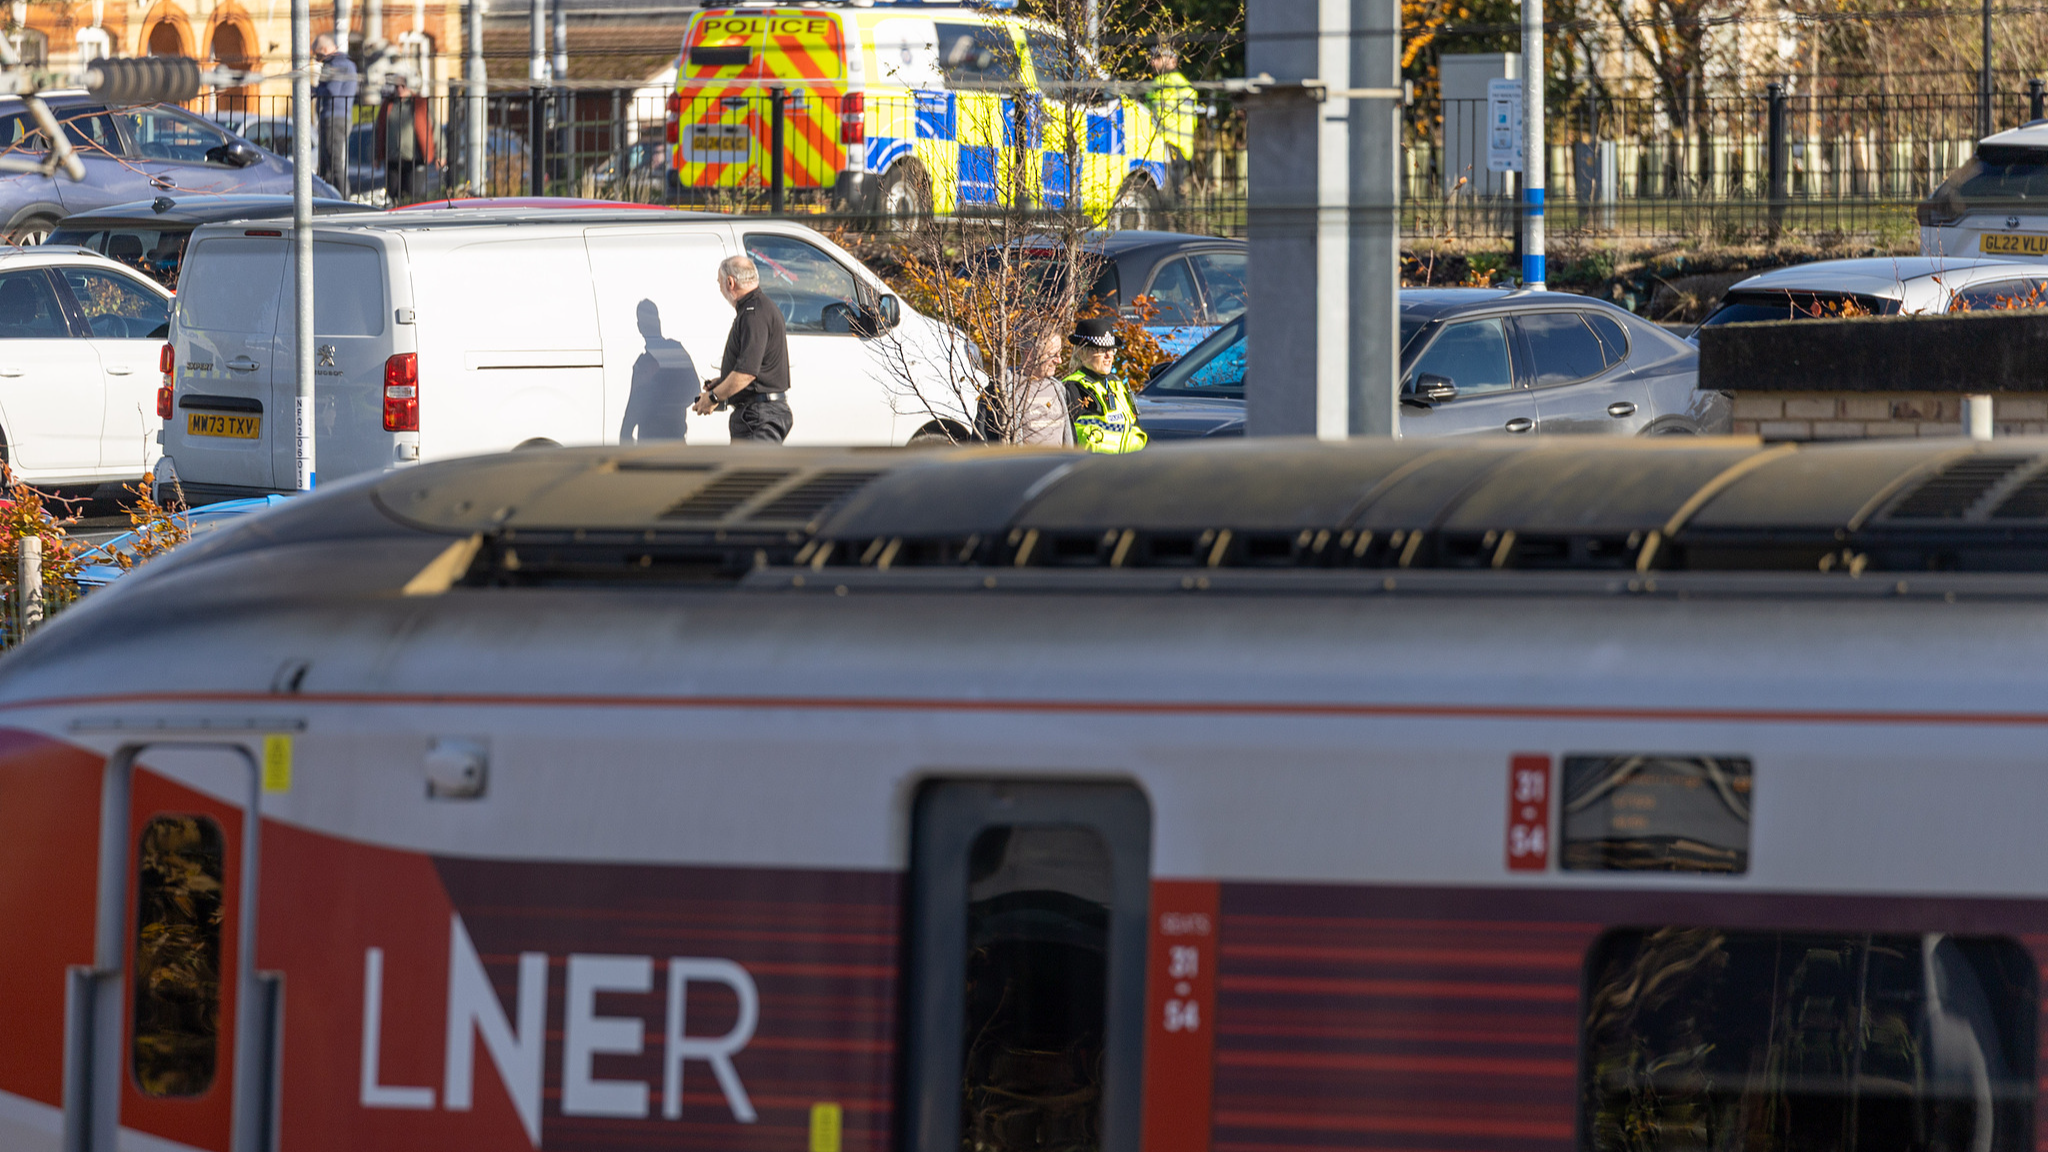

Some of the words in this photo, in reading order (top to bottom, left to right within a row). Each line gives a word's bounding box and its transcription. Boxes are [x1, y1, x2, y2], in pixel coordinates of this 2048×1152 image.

[703, 19, 826, 34] POLICE
[1985, 235, 2018, 250] GL22
[2022, 236, 2048, 252] VLU
[186, 362, 214, 371] EXPERT
[193, 415, 225, 433] MW73
[228, 417, 254, 435] TXV
[1514, 770, 1546, 802] 31
[1510, 824, 1546, 858] 54
[1168, 945, 1200, 979] 31
[360, 911, 760, 1149] LNER
[1163, 999, 1201, 1034] 54
